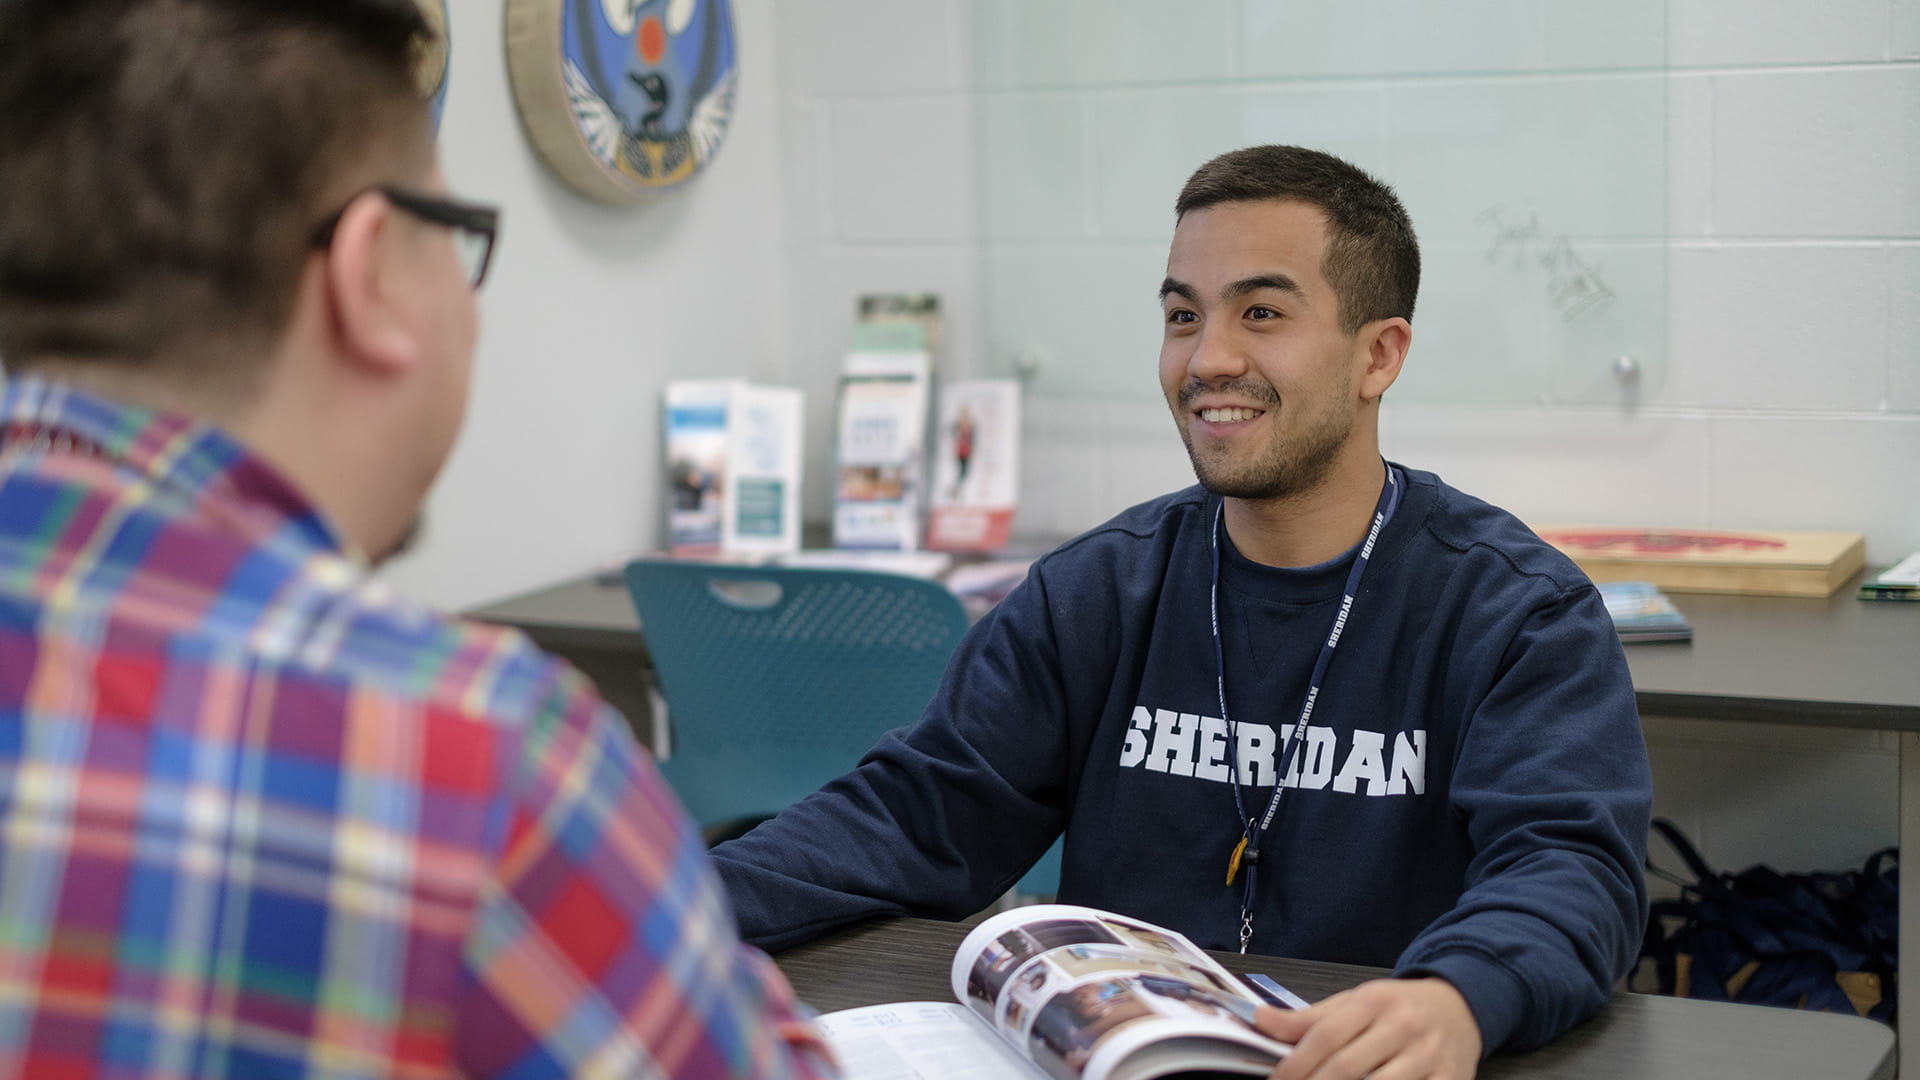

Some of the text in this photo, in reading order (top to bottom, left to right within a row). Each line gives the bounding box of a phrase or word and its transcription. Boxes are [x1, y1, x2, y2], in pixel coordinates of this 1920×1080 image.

[1361, 511, 1385, 560] SHERIDAN
[1328, 594, 1354, 648] SHERIDAN
[1119, 705, 1427, 797] SHERIDAN
